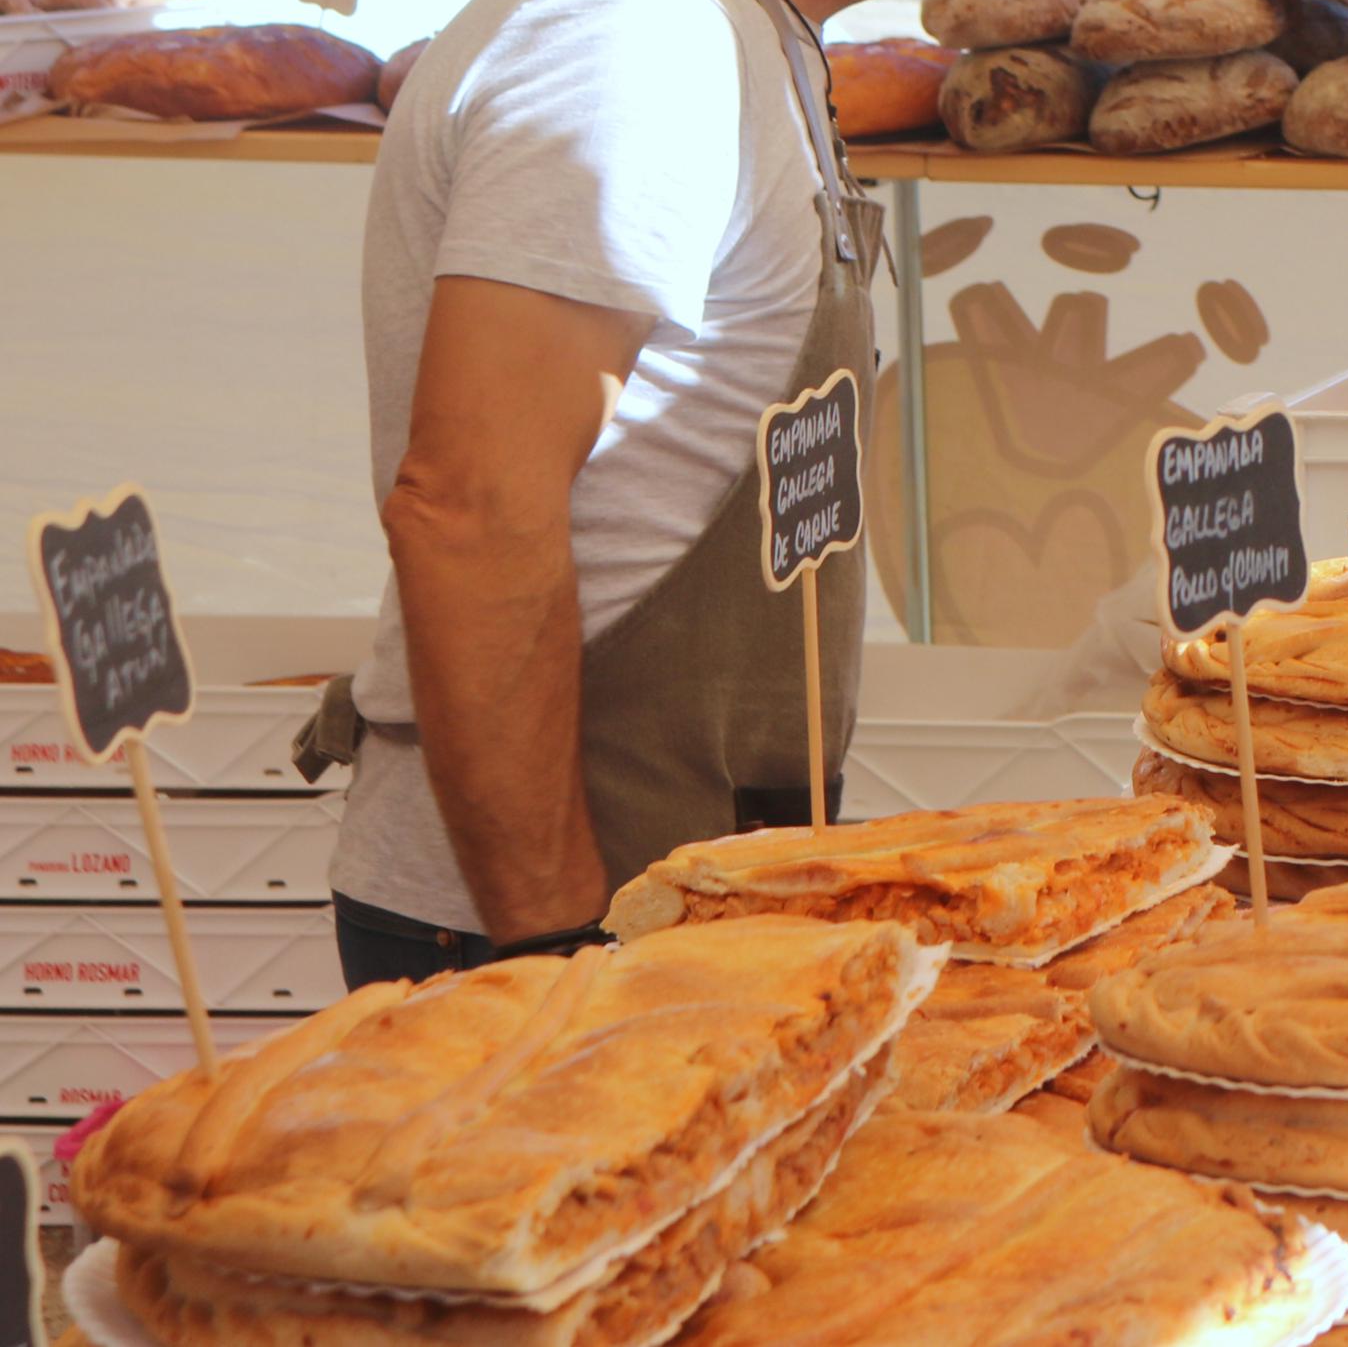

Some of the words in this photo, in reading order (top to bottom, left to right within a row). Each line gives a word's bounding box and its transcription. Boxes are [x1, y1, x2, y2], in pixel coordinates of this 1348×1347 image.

[769, 401, 841, 466] EMPANADA
[1163, 429, 1263, 486] EMPANADA
[773, 531, 789, 573] DE
[794, 499, 842, 555] CARNE
[1172, 565, 1218, 610] POLLO
[71, 853, 131, 874] LOZANO
[24, 962, 73, 983] HORNO
[77, 962, 140, 983] ROSMAR
